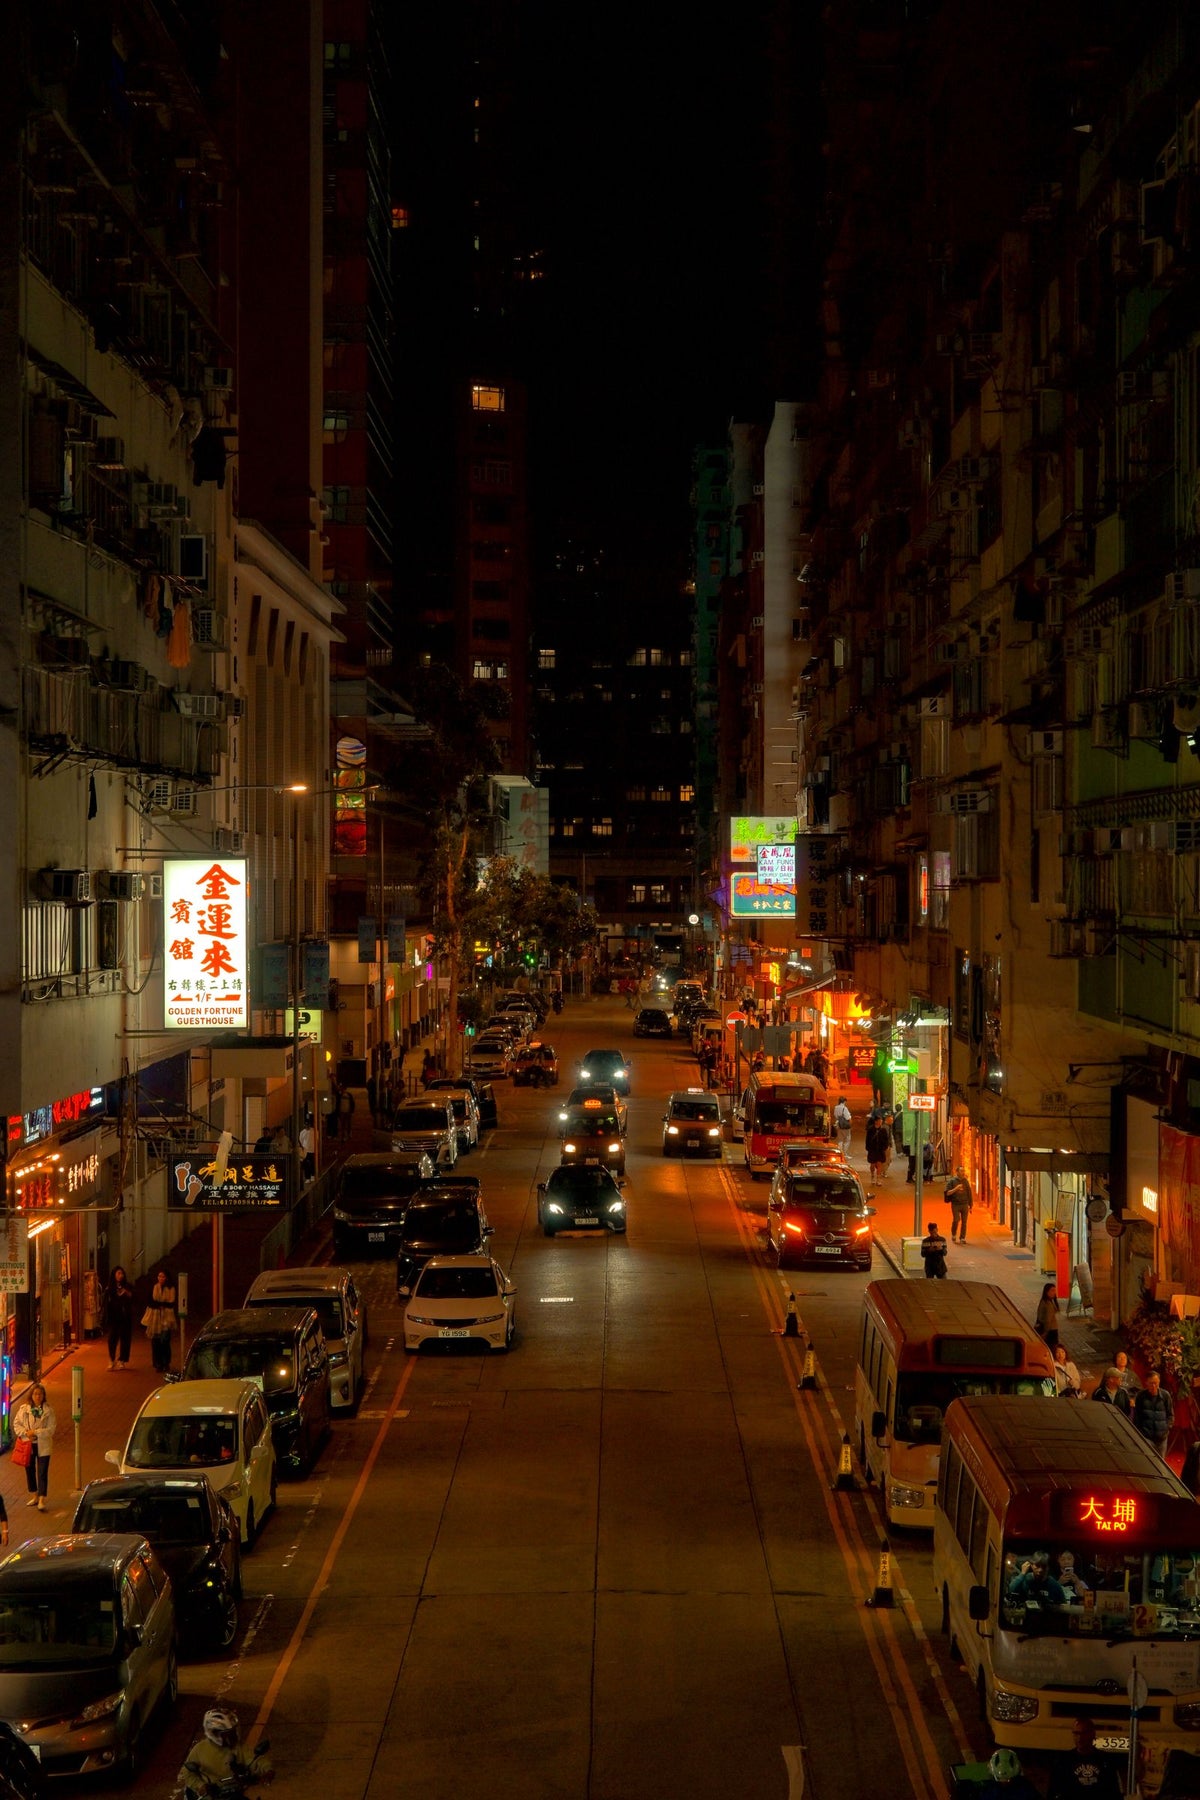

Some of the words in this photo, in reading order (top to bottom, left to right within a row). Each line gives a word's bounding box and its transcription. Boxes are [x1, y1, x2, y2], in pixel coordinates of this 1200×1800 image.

[759, 847, 794, 859] 金鳳凰
[195, 863, 241, 978] 金運來
[169, 898, 195, 961] 賓館
[195, 993, 212, 1003] 1/F
[168, 1007, 202, 1015] GOLDEN
[204, 1007, 243, 1015] FORTUNE
[176, 1017, 234, 1025] GUESTHOUSE
[1080, 1497, 1136, 1522] 大埔
[1096, 1521, 1112, 1531] TAI
[1114, 1522, 1127, 1531] PO
